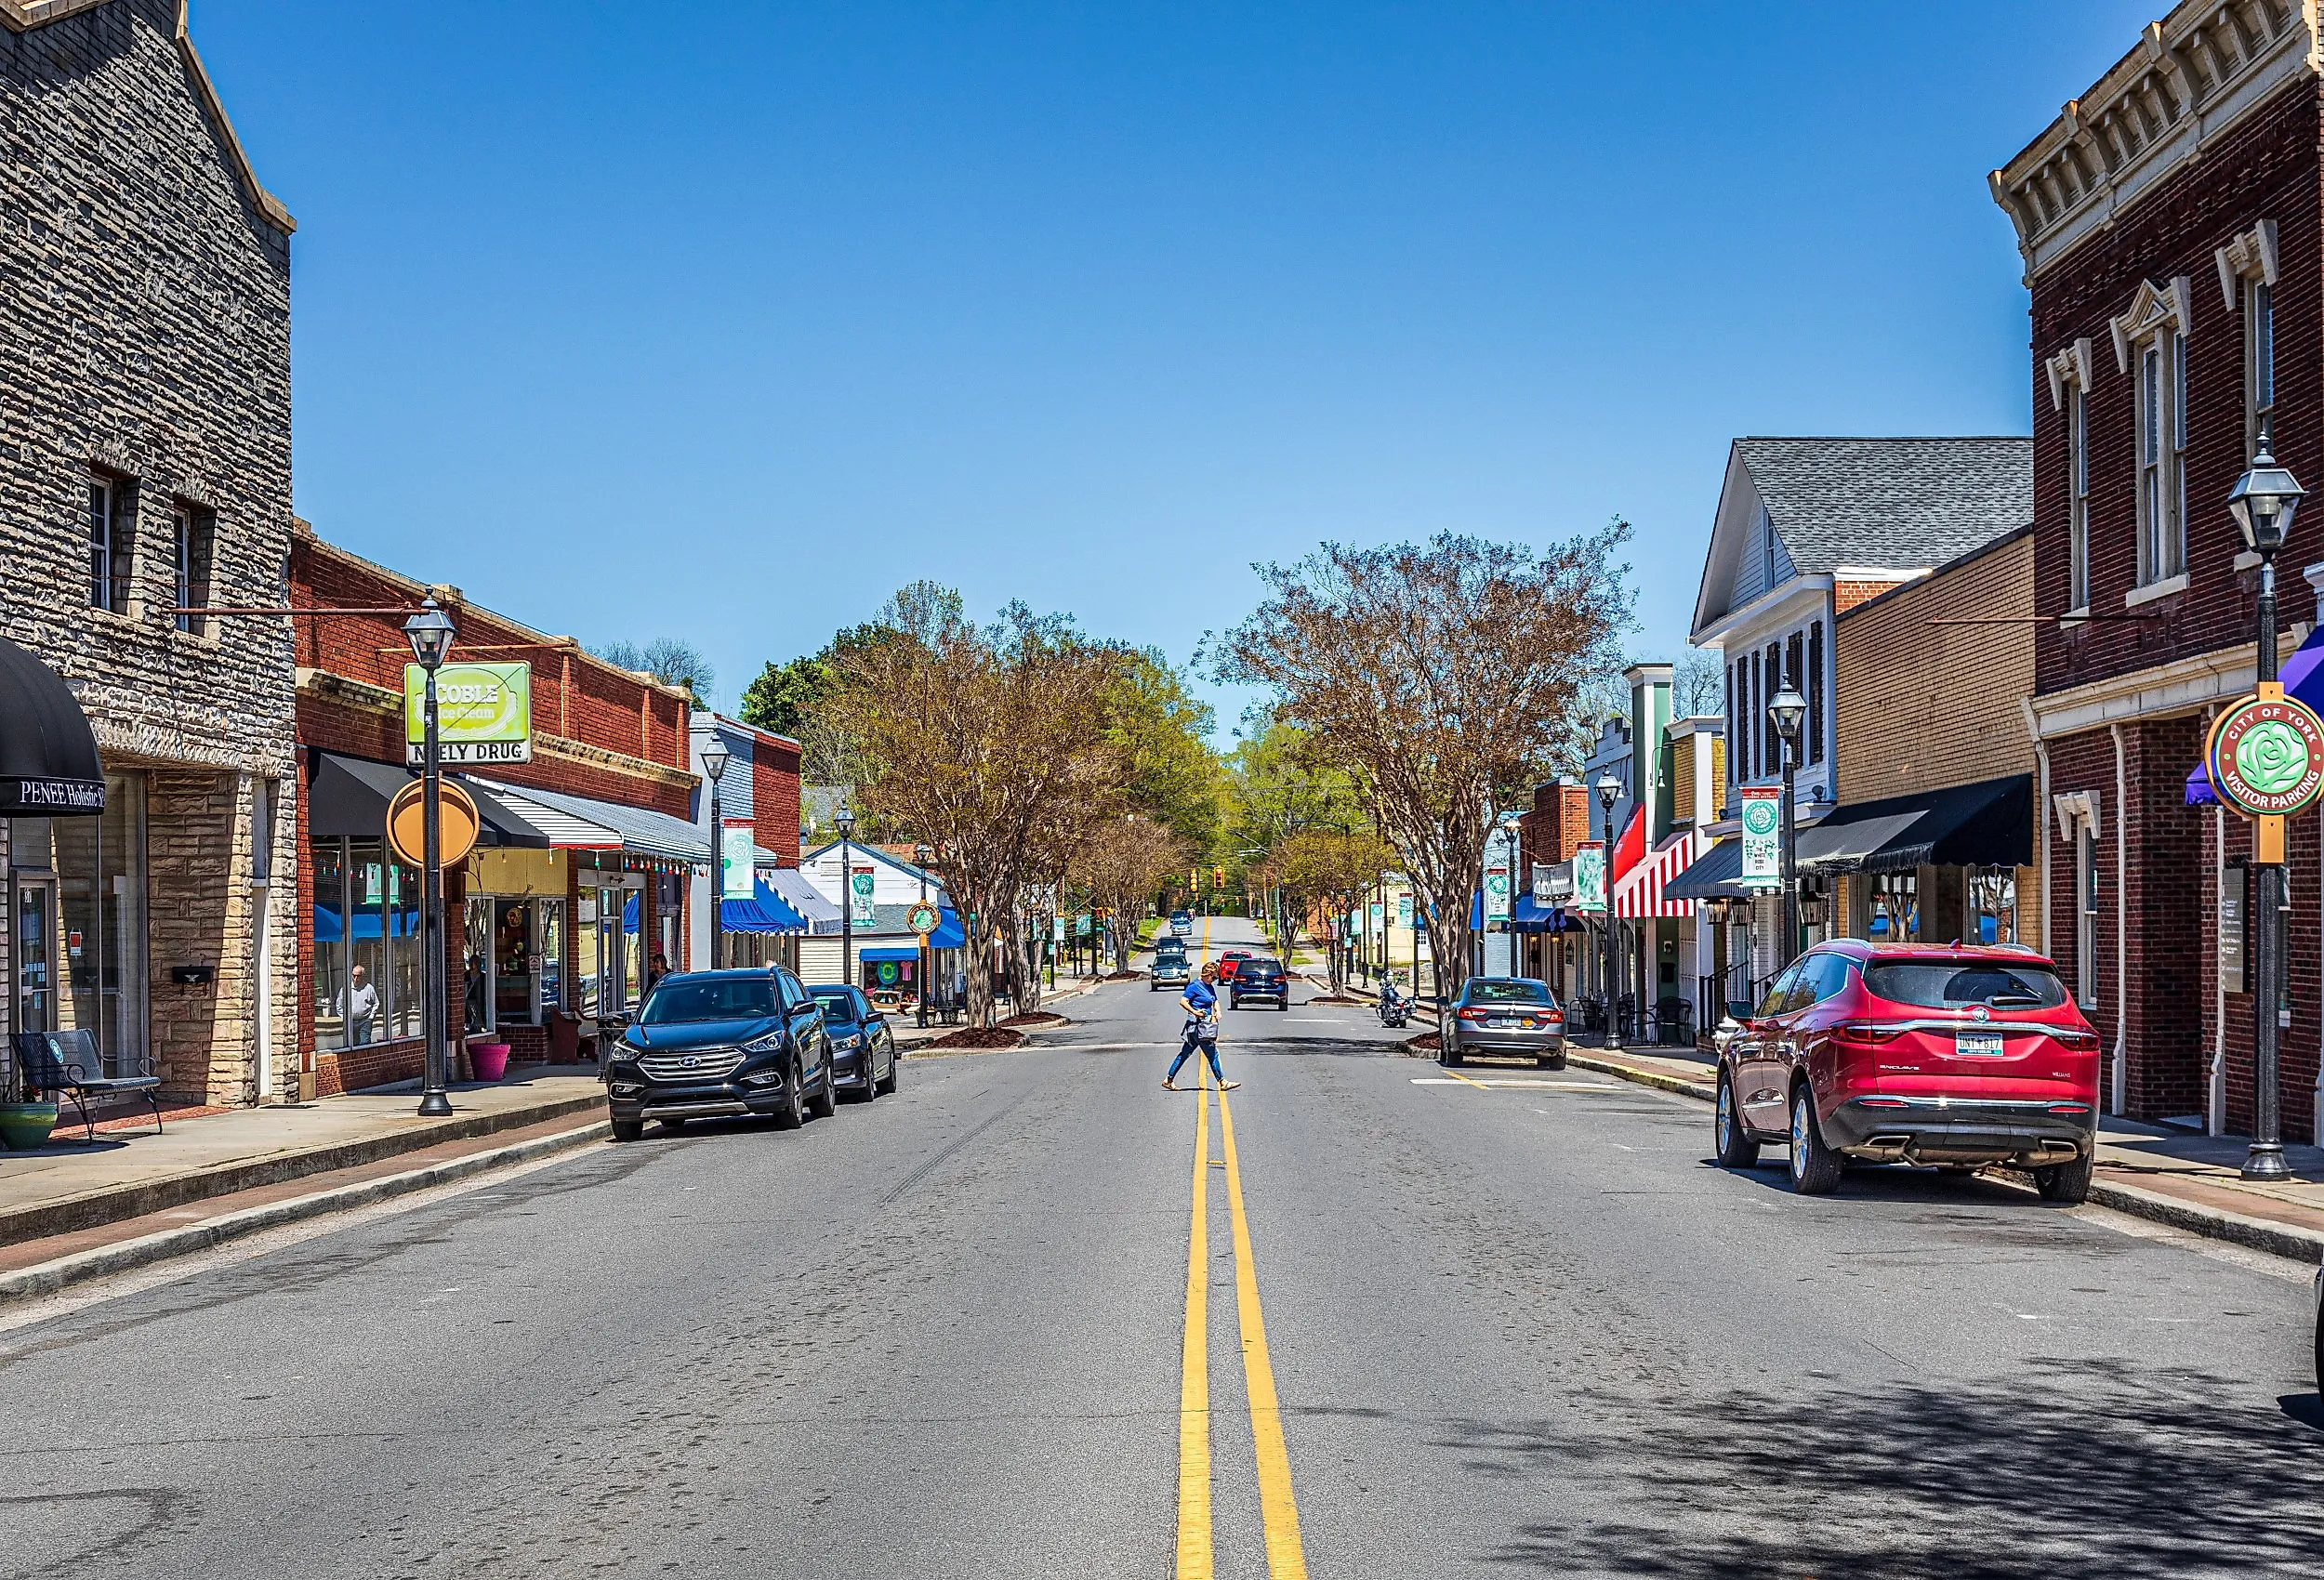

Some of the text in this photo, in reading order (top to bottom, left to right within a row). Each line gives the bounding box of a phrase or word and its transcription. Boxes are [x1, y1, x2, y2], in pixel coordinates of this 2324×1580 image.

[436, 684, 498, 704] COBLE
[438, 706, 495, 719] Ice Cream
[2228, 707, 2318, 744] CITY OF YORK
[414, 744, 522, 761] NELY DRUG
[20, 781, 67, 805] PENEE
[65, 783, 98, 808] Holistic
[2225, 769, 2319, 808] VISITOR PARKING
[1959, 1036, 1975, 1048] UNT
